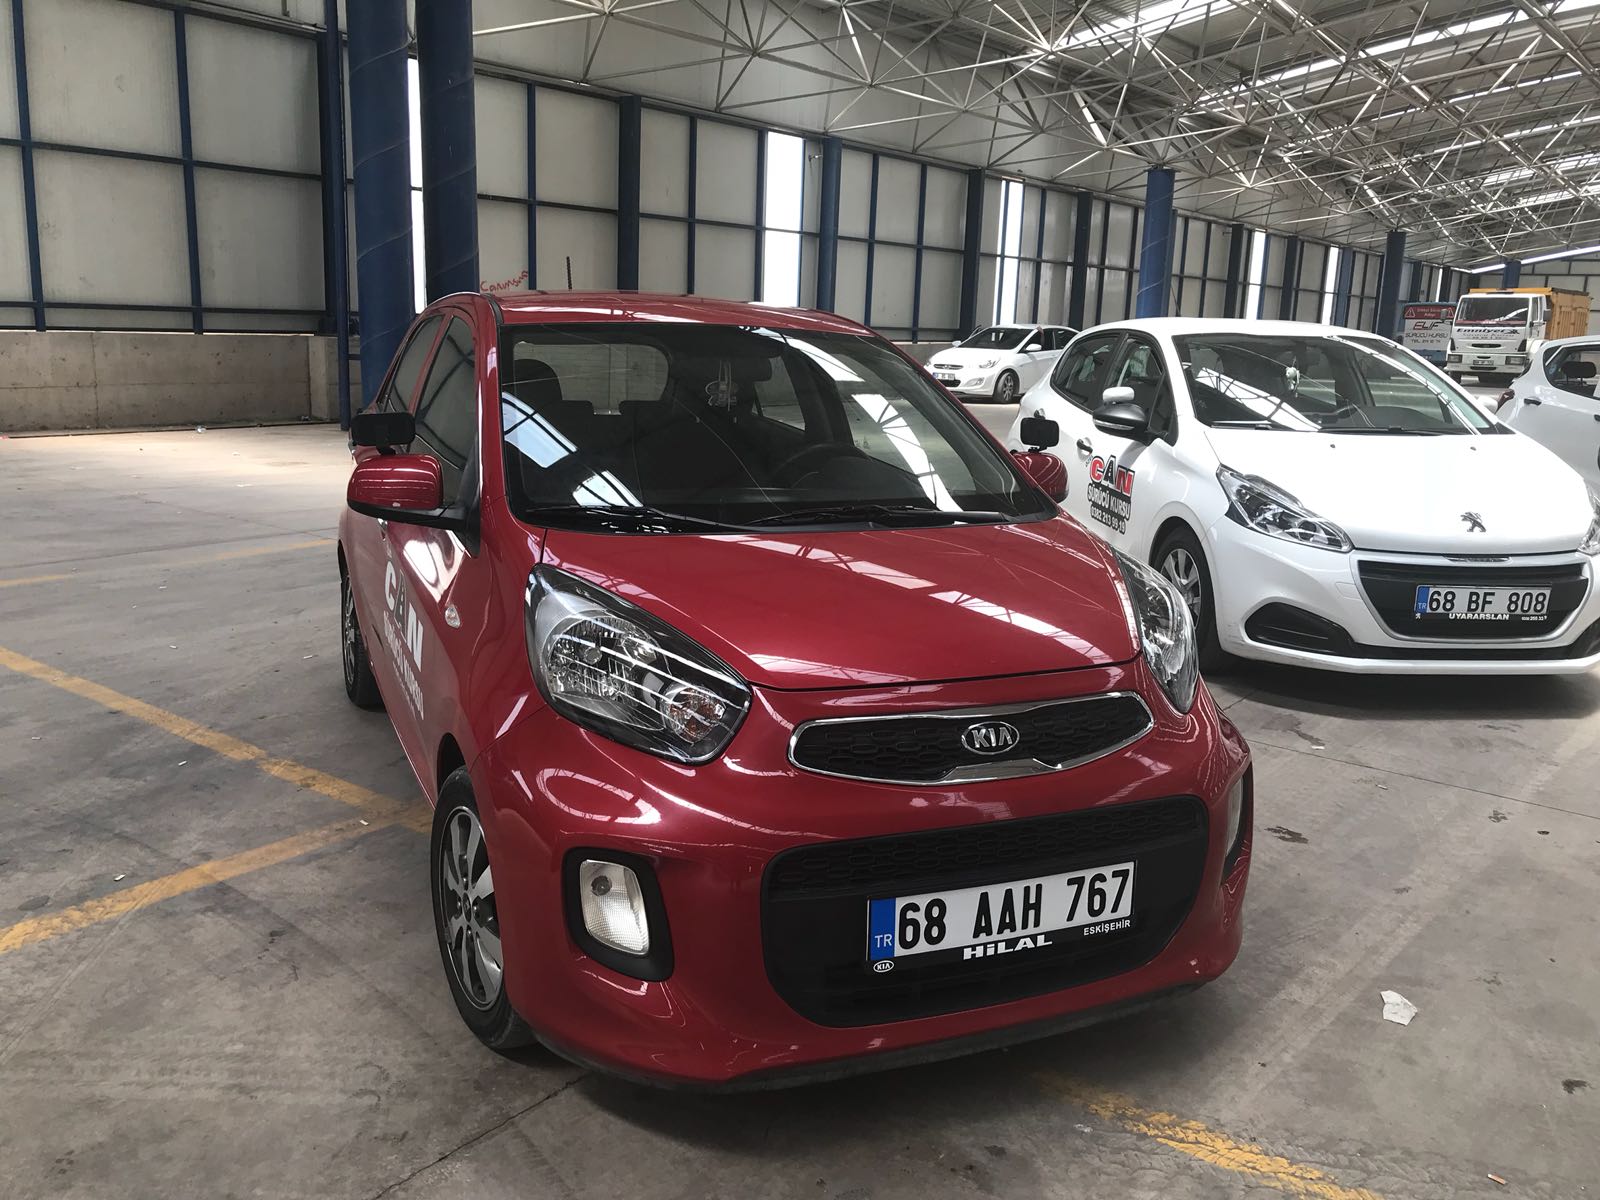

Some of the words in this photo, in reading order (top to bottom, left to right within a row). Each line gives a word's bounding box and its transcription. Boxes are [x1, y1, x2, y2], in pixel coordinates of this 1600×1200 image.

[1090, 455, 1135, 497] CAN
[1088, 484, 1109, 509] SÜRÜCÜ
[1110, 496, 1131, 521] KURSU
[1429, 590, 1456, 612] 68
[1467, 591, 1495, 613] BF
[1507, 592, 1547, 613] 808
[1449, 613, 1510, 621] UYARARSLAN
[968, 725, 1015, 750] KIA
[874, 933, 892, 949] TR
[899, 898, 947, 950] 68
[972, 883, 1043, 939] AAH
[1066, 868, 1130, 922] 767
[1083, 919, 1131, 936] ESKİŞEHİR
[874, 961, 893, 972] KIA
